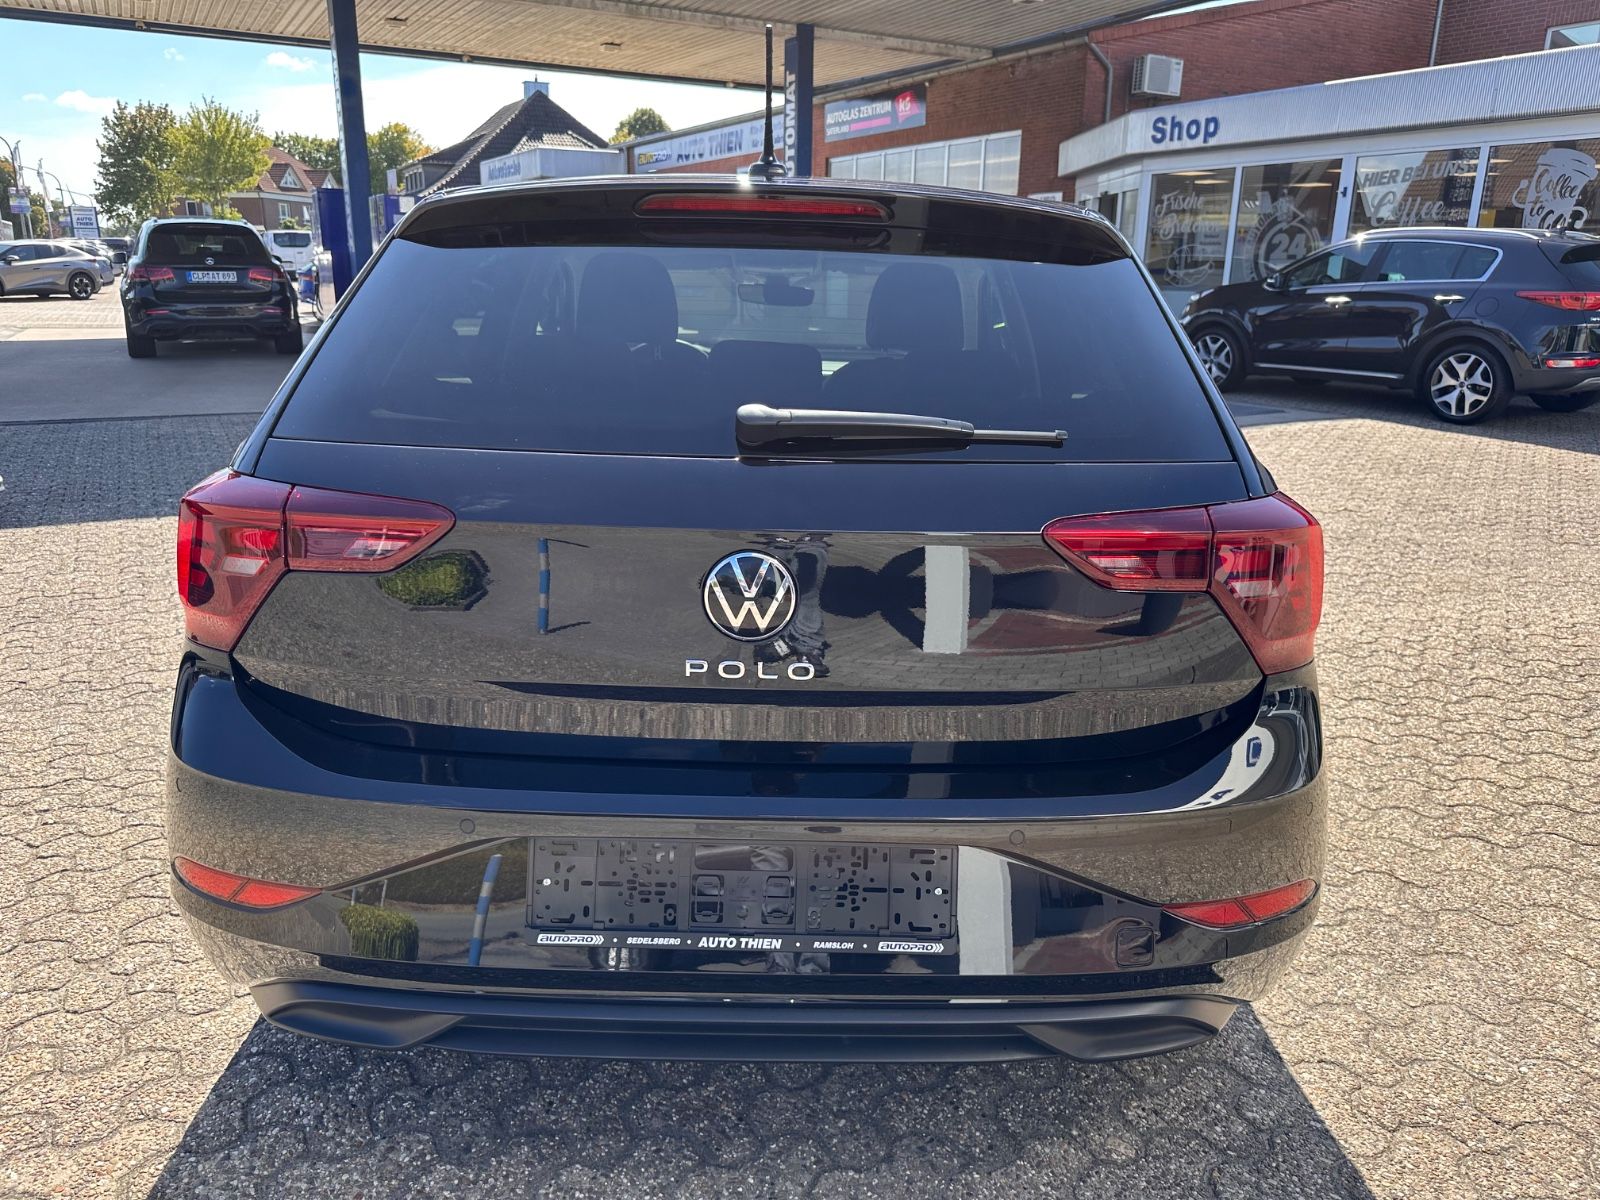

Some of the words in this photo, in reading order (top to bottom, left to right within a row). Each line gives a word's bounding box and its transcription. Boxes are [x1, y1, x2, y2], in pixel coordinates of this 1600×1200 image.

[785, 70, 796, 177] UTOMAT
[826, 107, 859, 125] AUTOGLAS
[860, 100, 892, 118] ZENTRUM
[1151, 115, 1220, 144] Shop
[676, 137, 706, 163] AUTO
[708, 129, 744, 157] THIEN
[1363, 168, 1400, 188] HIER
[1401, 163, 1431, 182] BEI
[1432, 158, 1470, 177] UNS
[1535, 168, 1578, 200] Coffee
[1155, 190, 1204, 217] Frische
[1371, 191, 1445, 227] Coffee
[1269, 233, 1308, 261] 24
[685, 659, 815, 680] POLO
[626, 936, 681, 946] SEDELSBERG
[698, 936, 736, 948] AUTO
[739, 937, 782, 949] THIEN
[813, 941, 854, 949] RAMSLOH
